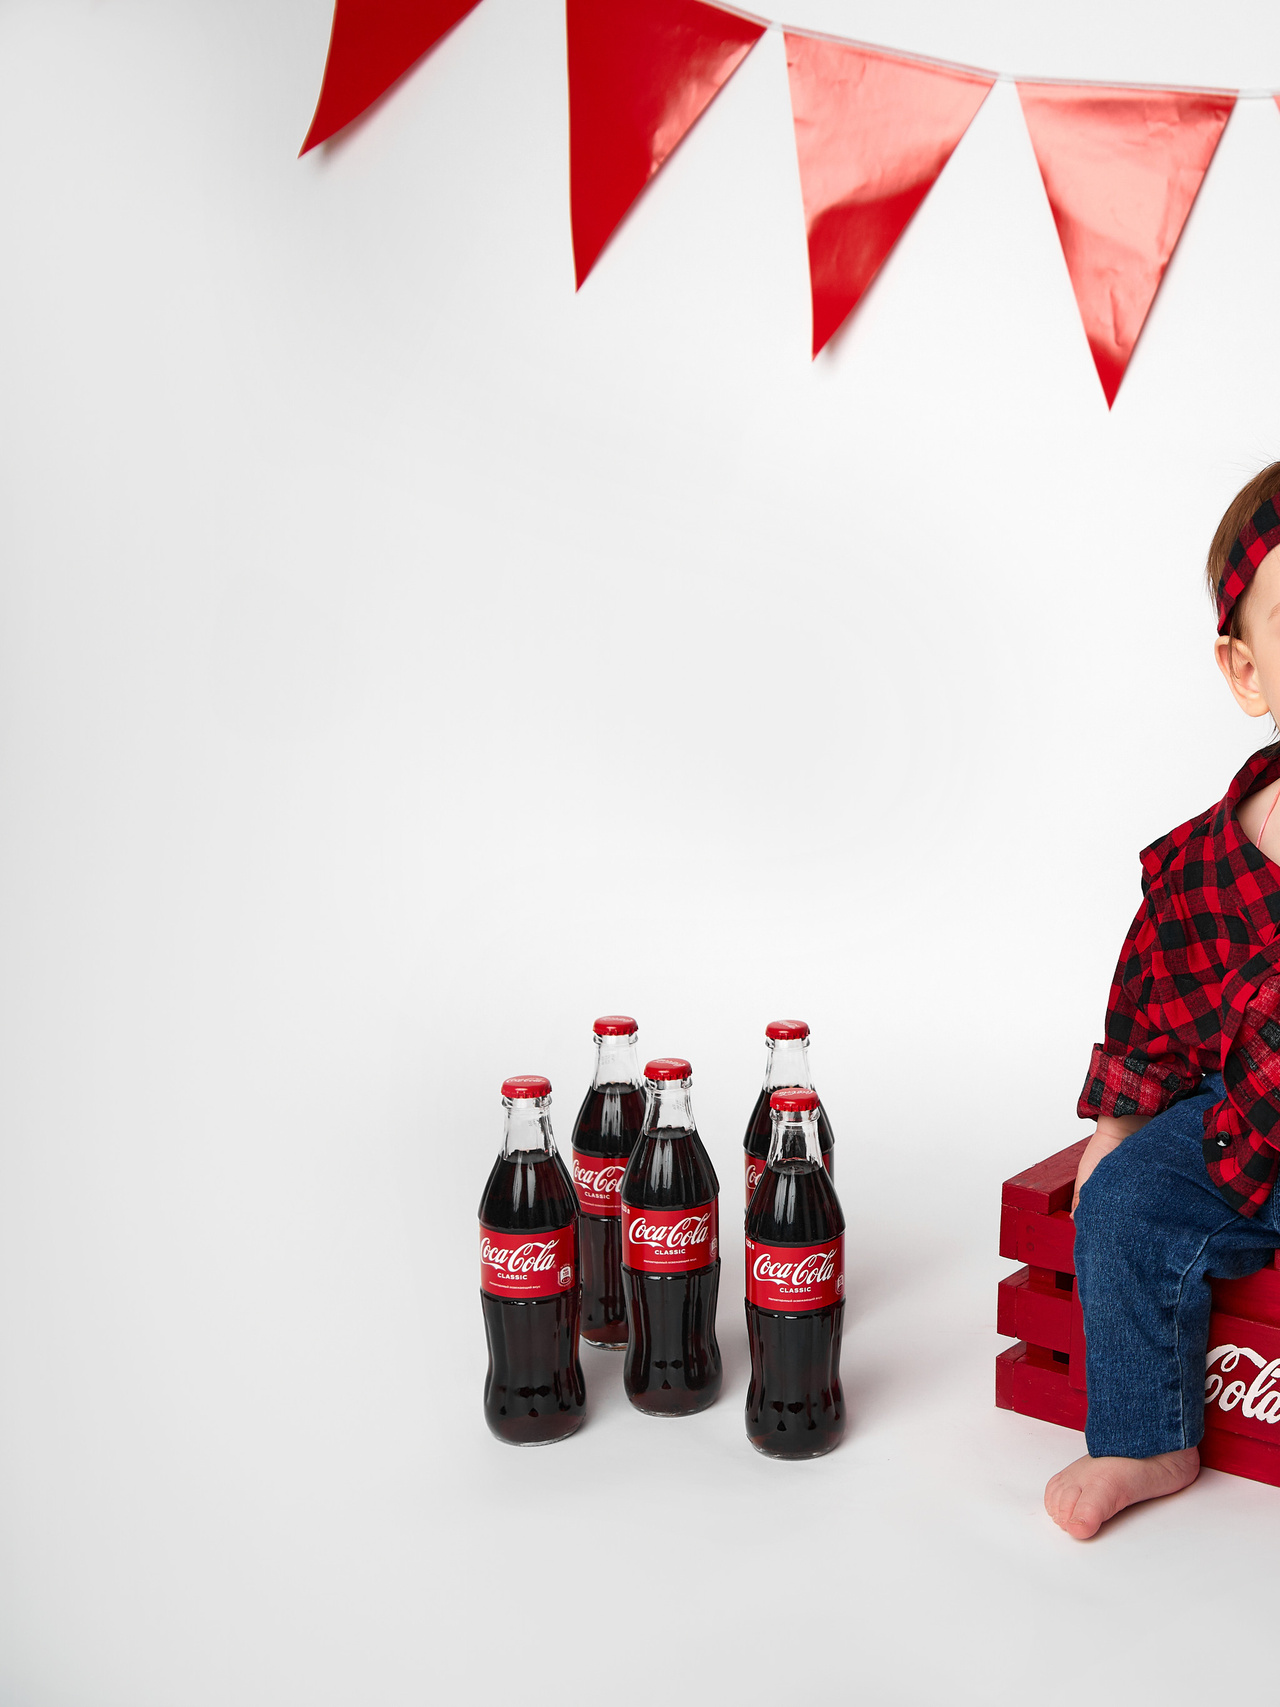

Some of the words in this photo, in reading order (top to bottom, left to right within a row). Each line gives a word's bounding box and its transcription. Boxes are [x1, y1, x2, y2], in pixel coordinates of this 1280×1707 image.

[573, 1159, 626, 1193] Coca-Col
[584, 1191, 611, 1200] CLASSIC
[628, 1212, 712, 1248] Coca-Cola
[480, 1237, 560, 1273] Coca-Cola
[753, 1248, 838, 1286] Coca-Cola
[497, 1272, 528, 1280] CLASSIC
[779, 1286, 812, 1294] CLASSIC
